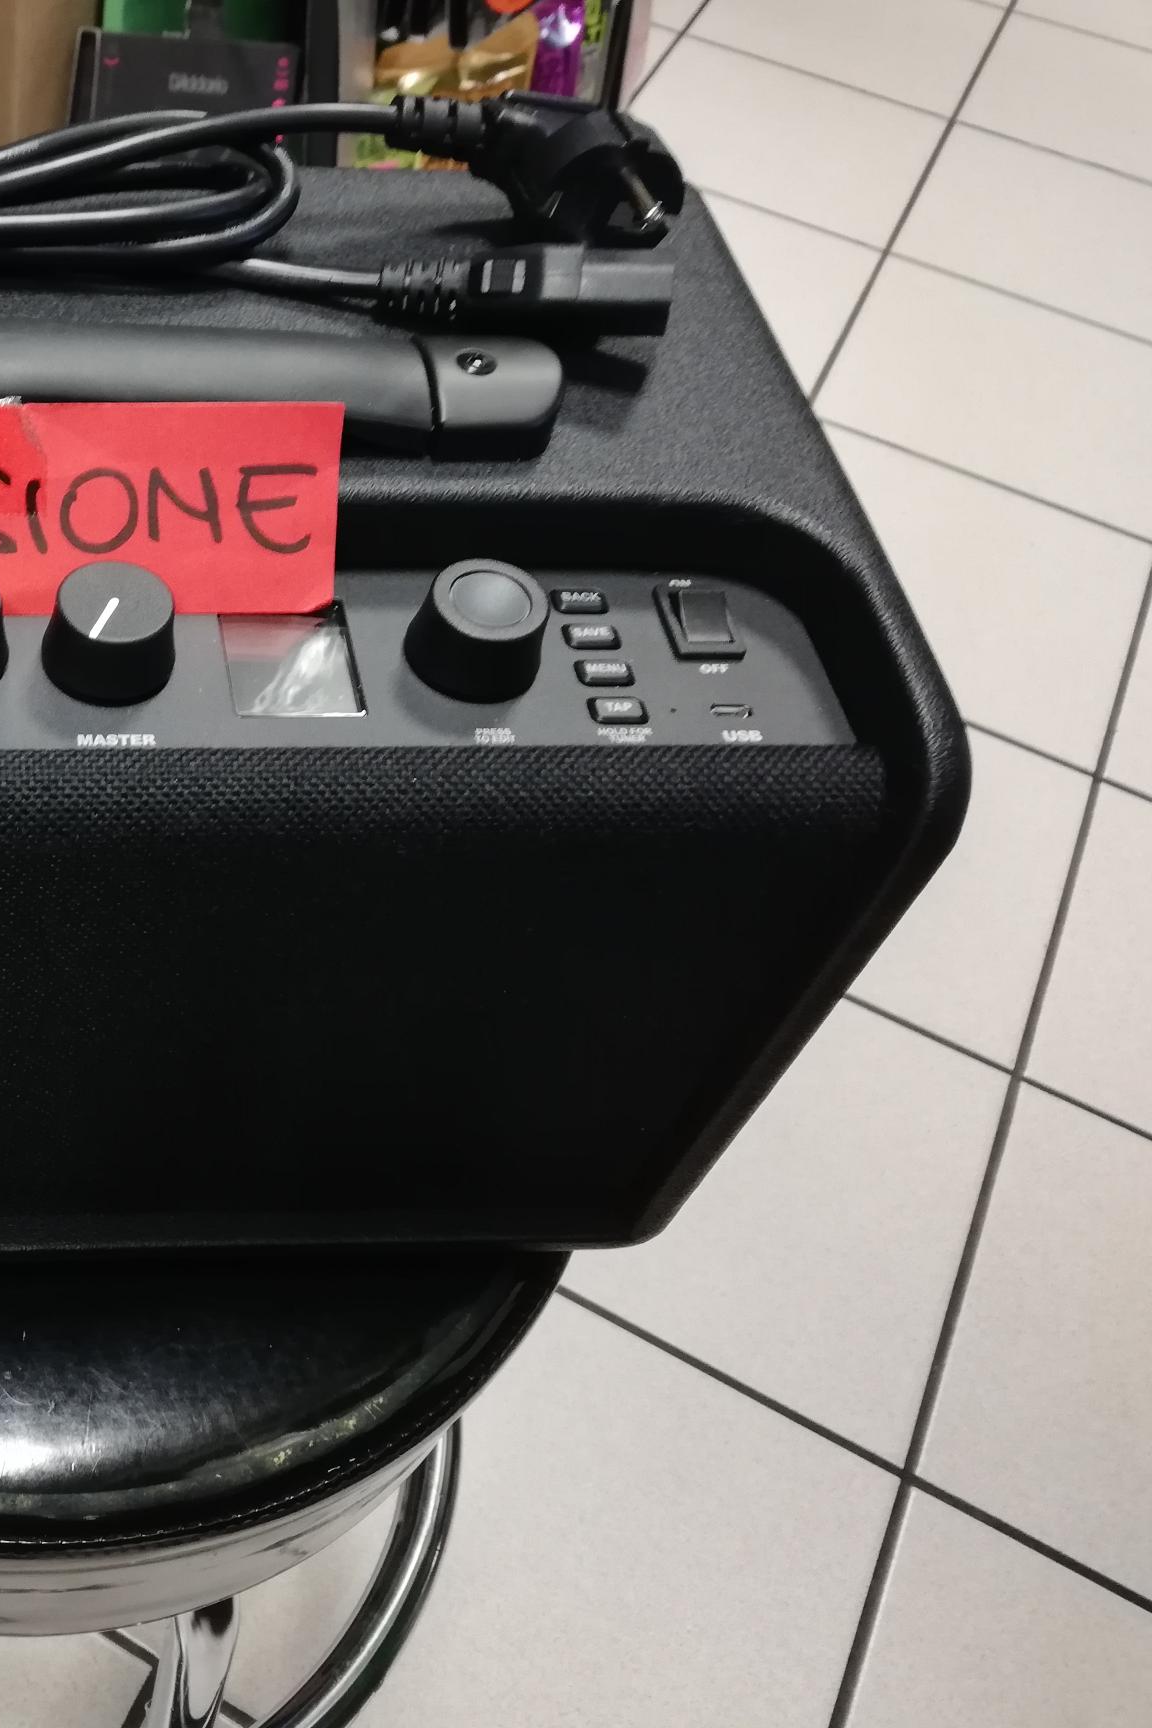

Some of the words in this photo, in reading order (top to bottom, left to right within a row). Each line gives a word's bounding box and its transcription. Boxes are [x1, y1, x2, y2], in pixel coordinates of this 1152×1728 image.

[560, 591, 602, 602] BACK
[571, 627, 611, 638] SAVE
[585, 663, 628, 674] MENU
[699, 663, 730, 675] OFF
[604, 702, 633, 713] TAP
[76, 733, 157, 748] MASTER
[722, 730, 763, 743] USB
